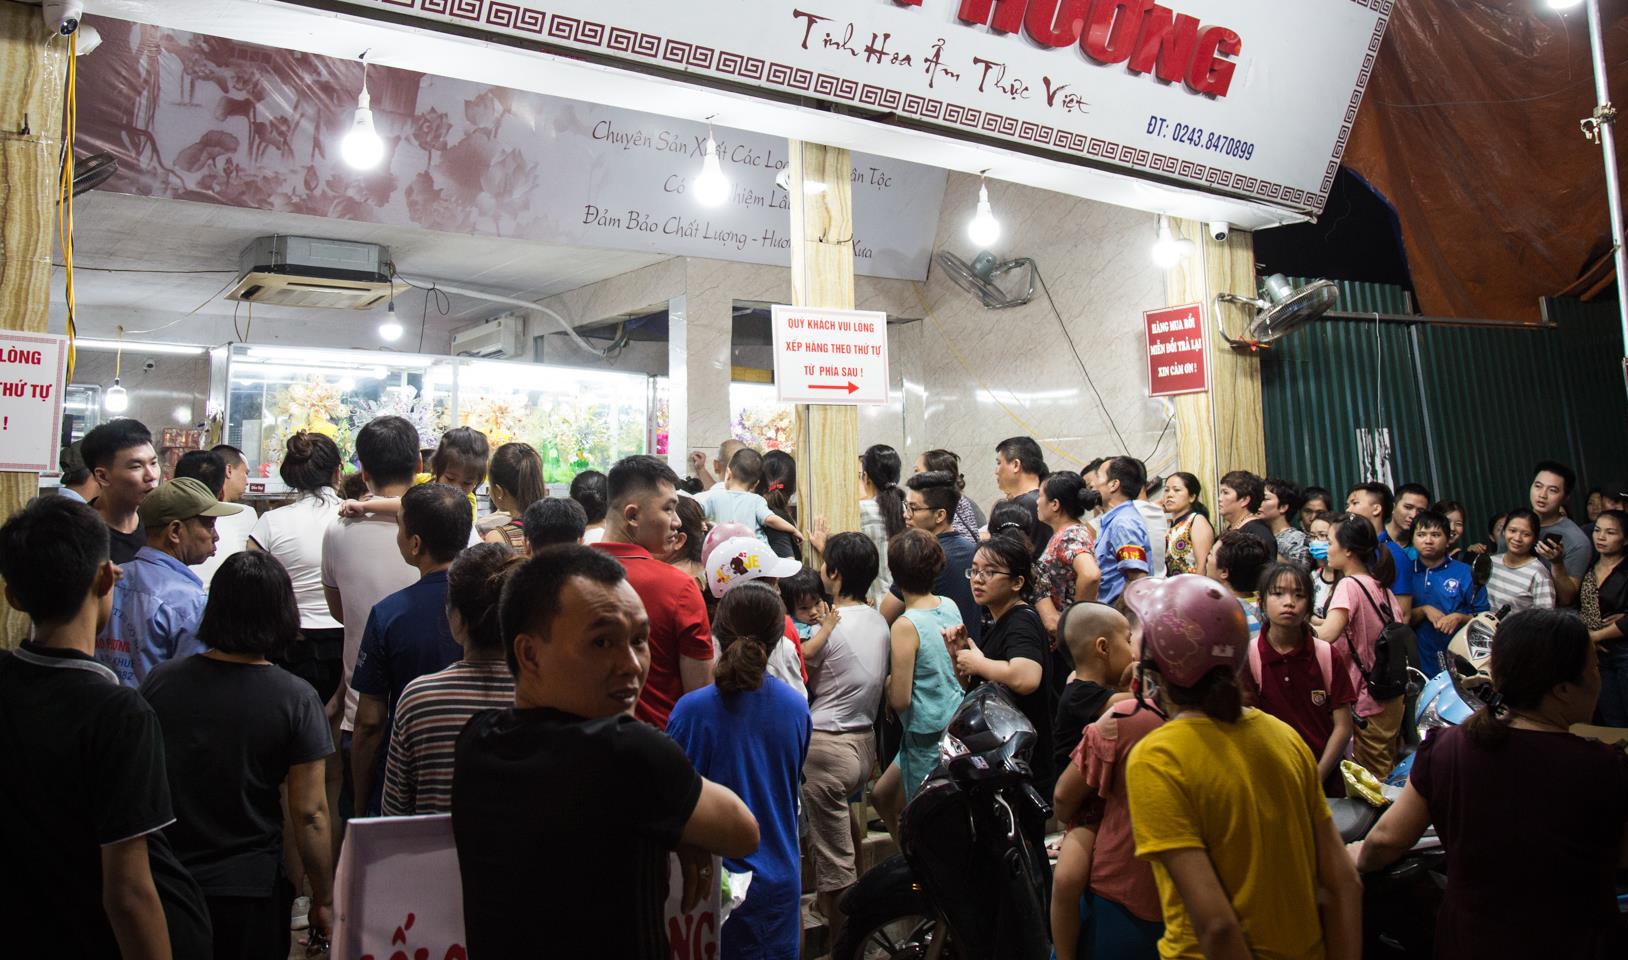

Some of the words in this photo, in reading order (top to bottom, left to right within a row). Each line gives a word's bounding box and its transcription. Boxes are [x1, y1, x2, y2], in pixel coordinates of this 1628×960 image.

[793, 9, 859, 57] Tinh
[864, 32, 912, 67] Hoa
[924, 38, 961, 88] Ẩm
[973, 56, 1030, 100] Thực
[1043, 76, 1091, 114] Việt
[1146, 115, 1169, 138] ĐT:
[1172, 122, 1255, 161] 0243.8470899
[592, 120, 651, 150] Chuyên
[656, 130, 687, 153] Sản
[731, 144, 761, 167] Các
[869, 167, 892, 191] Tộc
[663, 174, 685, 194] Có
[582, 204, 621, 229] Đảm
[626, 210, 658, 233] Bảo
[663, 216, 699, 238] Chất
[702, 221, 747, 251] Lượng
[808, 318, 836, 331] KHÁCH
[838, 321, 851, 332] VUI
[854, 321, 875, 333] LÒNG
[1170, 320, 1183, 331] MUA
[0, 346, 41, 365] LÒNG
[805, 340, 829, 353] HÀNG
[831, 343, 851, 354] THEO
[871, 345, 881, 358] TỰ
[841, 367, 858, 377] SAU
[1158, 366, 1169, 377] XIN
[30, 384, 52, 402] TỰ
[3, 415, 9, 430] !
